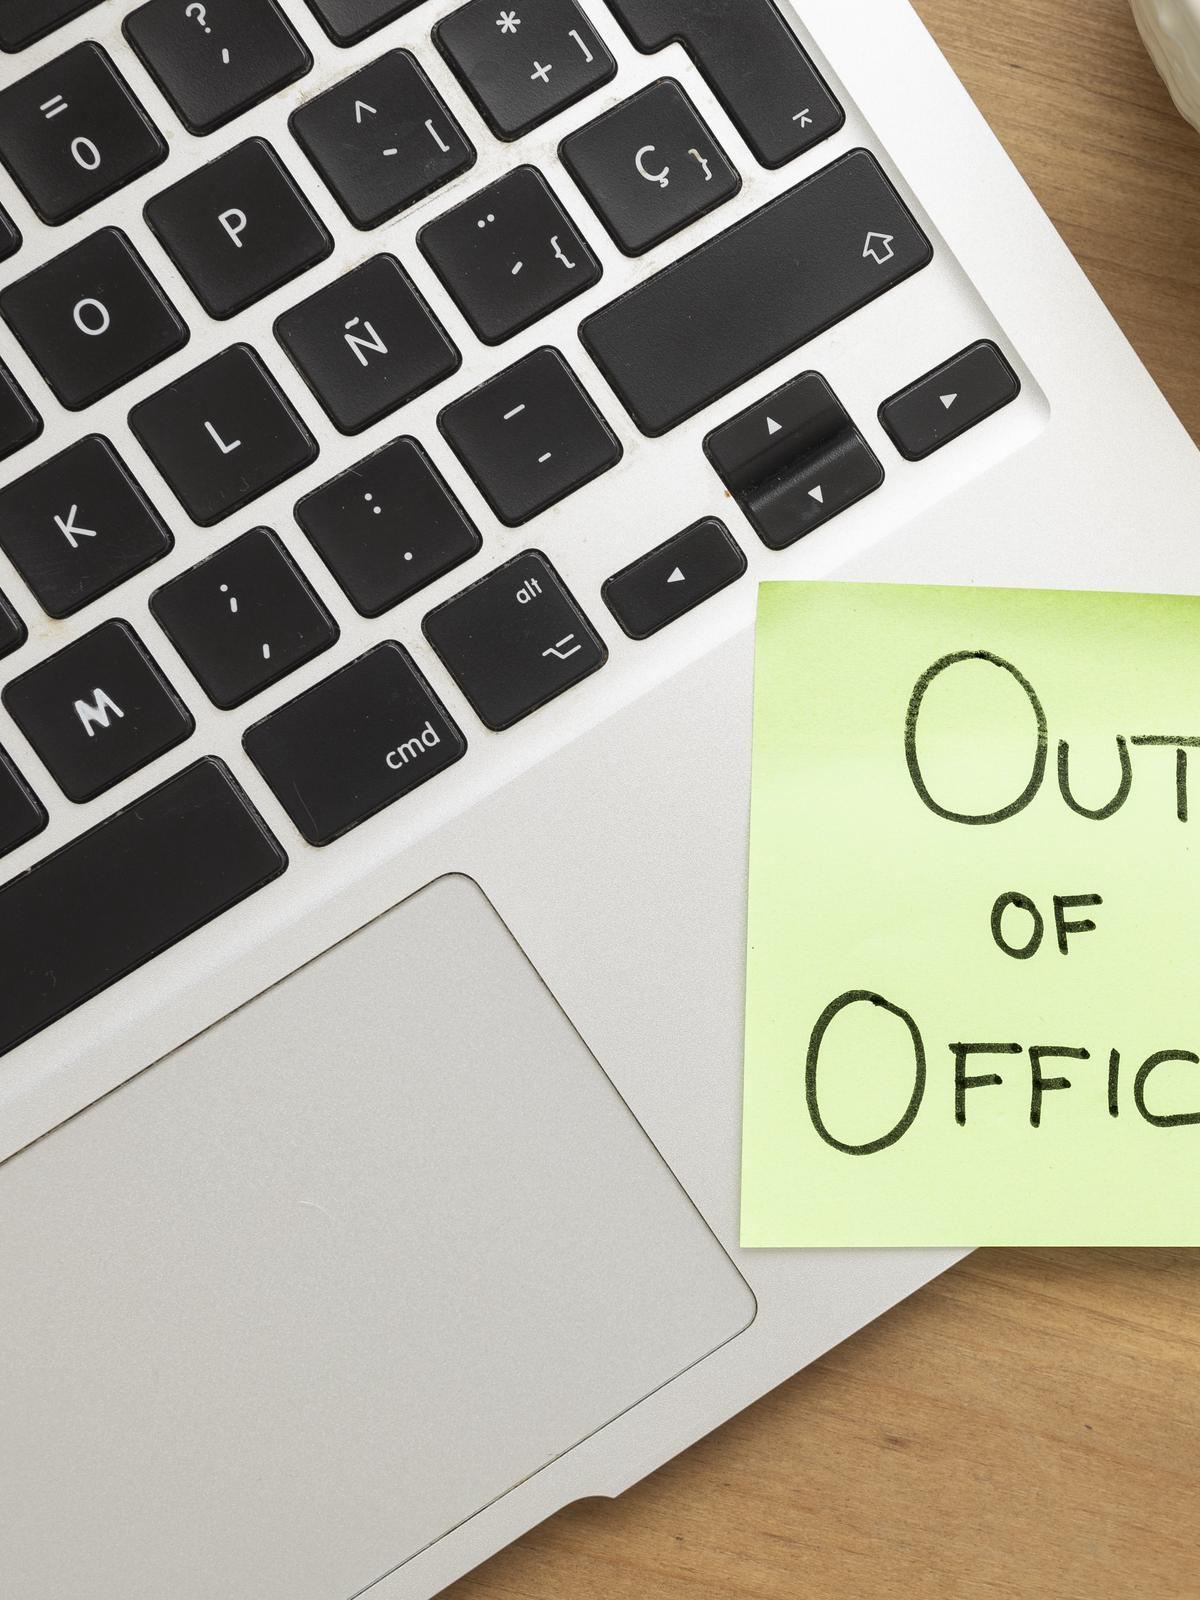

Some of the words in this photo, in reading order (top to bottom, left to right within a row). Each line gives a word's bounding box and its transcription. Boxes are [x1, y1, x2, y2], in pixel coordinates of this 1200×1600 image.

[634, 144, 670, 189] Ç
[217, 208, 247, 248] P
[73, 298, 110, 336] O
[343, 316, 388, 367] Ñ
[204, 421, 242, 454] L
[53, 504, 97, 548] K
[516, 577, 543, 604] alt
[74, 687, 125, 737] M
[385, 721, 441, 770] cmd
[991, 892, 1102, 959] OF
